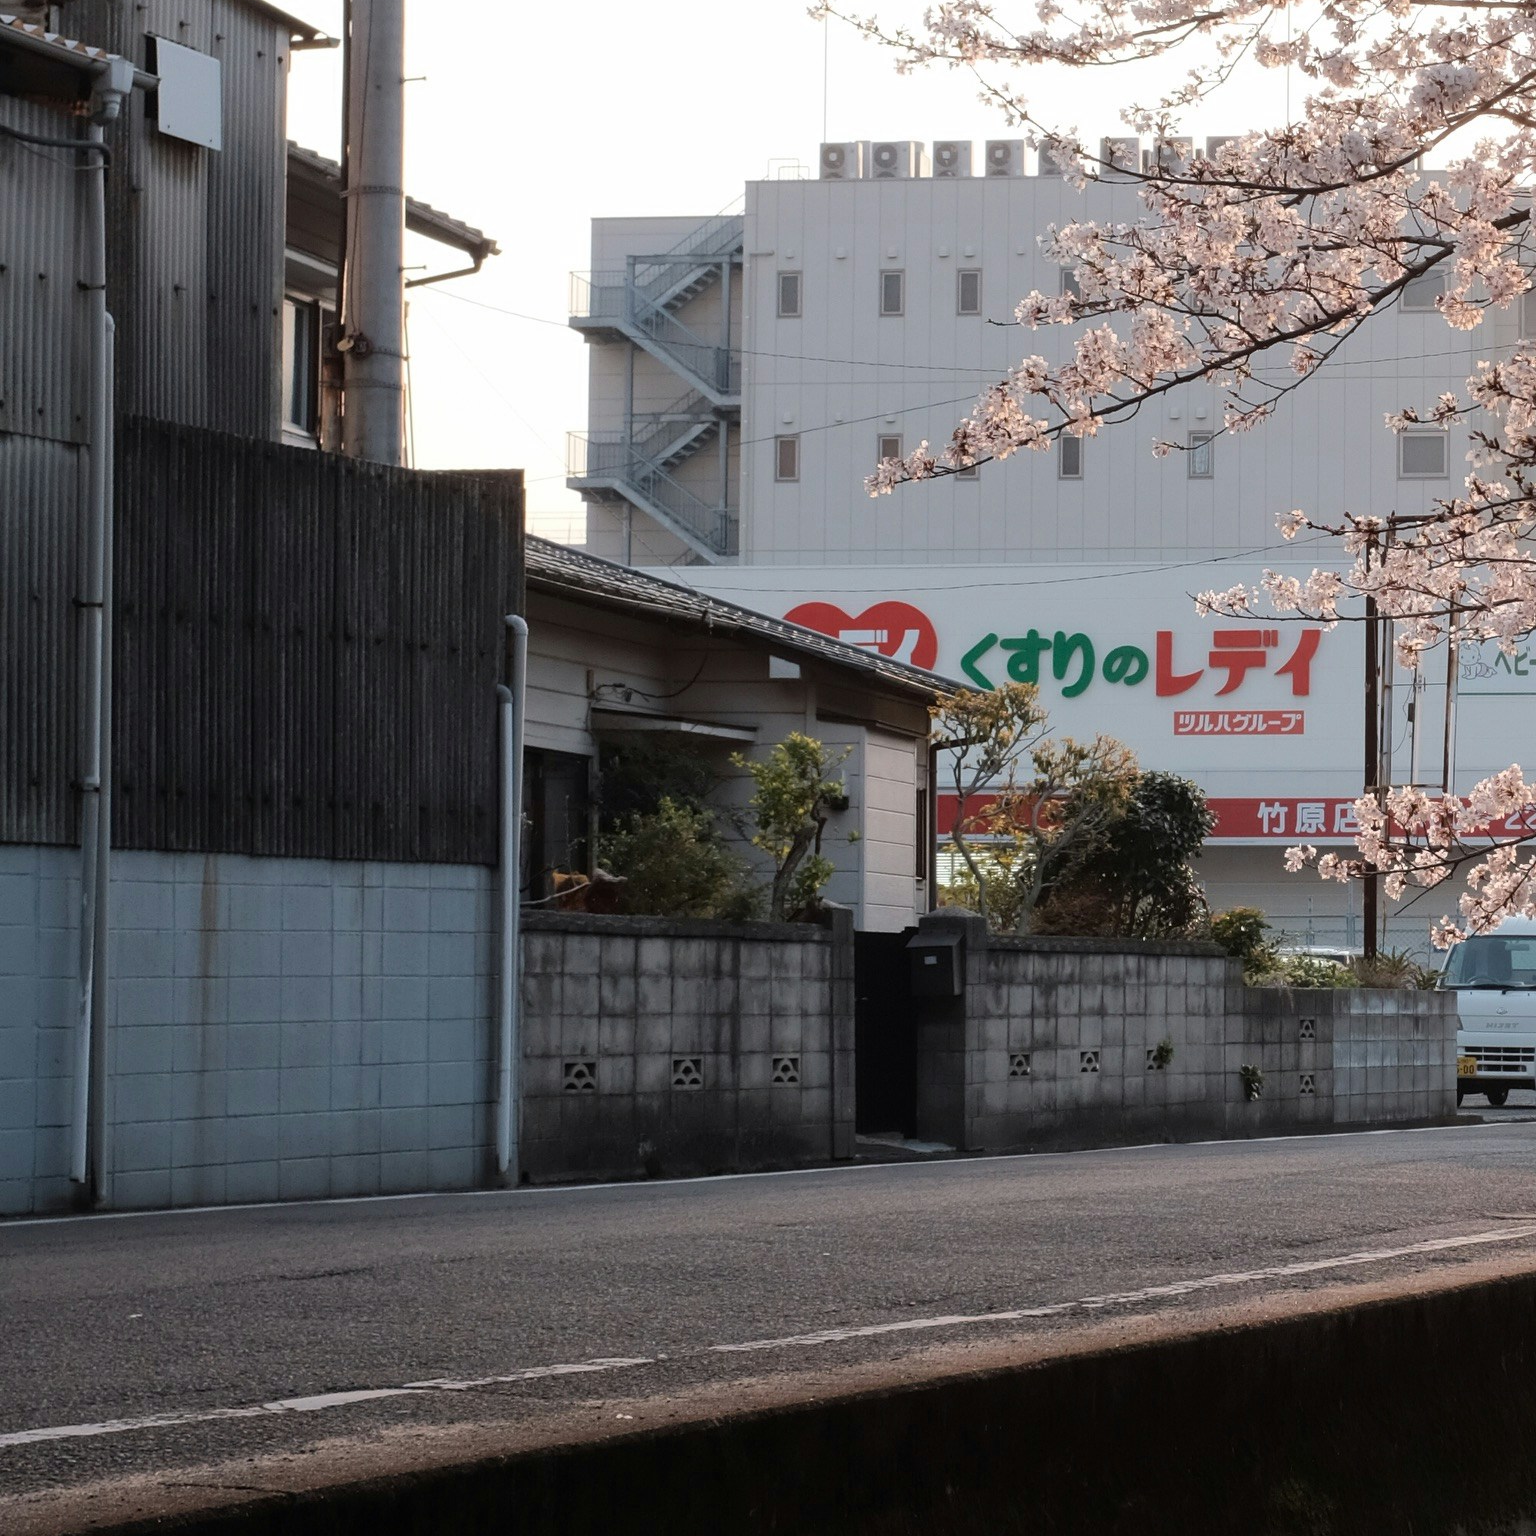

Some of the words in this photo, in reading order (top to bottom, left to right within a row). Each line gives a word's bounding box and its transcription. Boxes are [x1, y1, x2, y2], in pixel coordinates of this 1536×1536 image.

[1178, 713, 1302, 733] ツルハグループ
[1257, 801, 1362, 833] 竹原店
